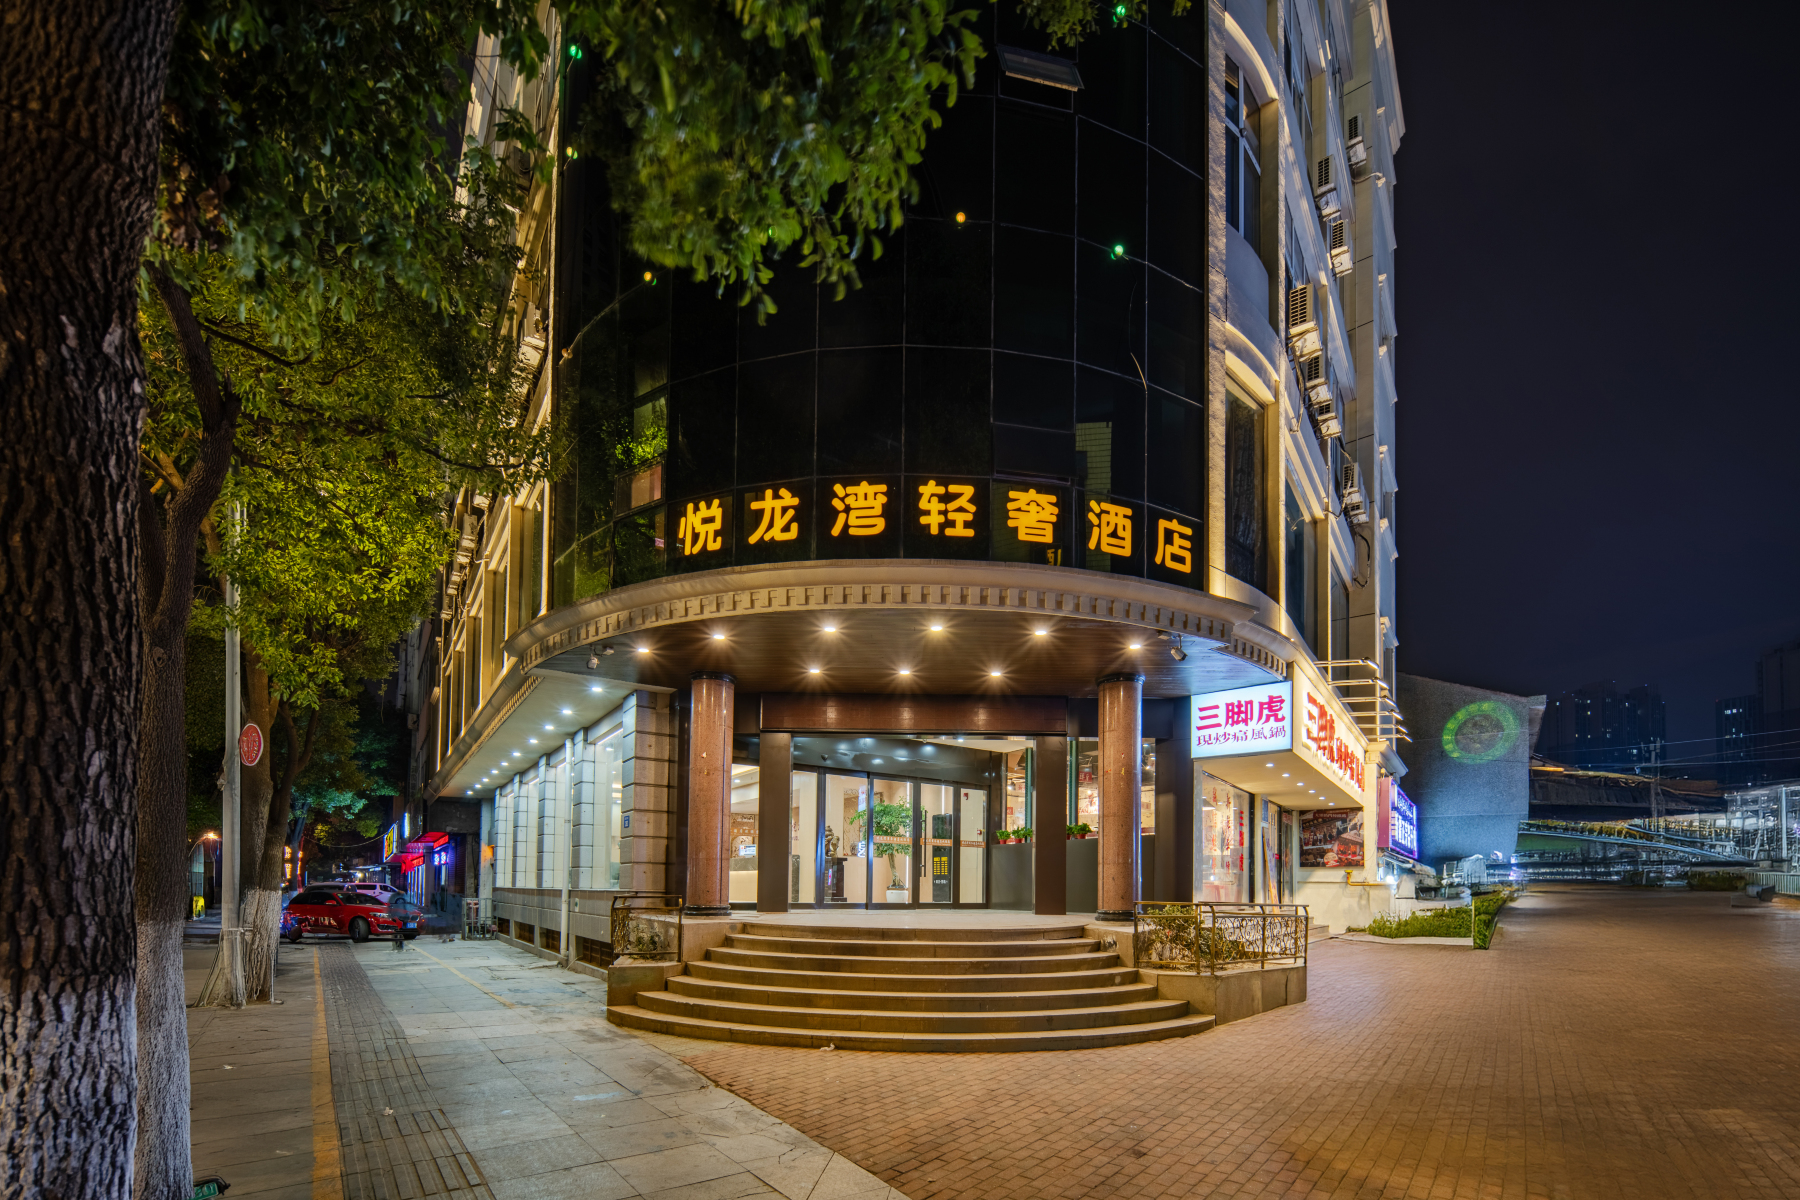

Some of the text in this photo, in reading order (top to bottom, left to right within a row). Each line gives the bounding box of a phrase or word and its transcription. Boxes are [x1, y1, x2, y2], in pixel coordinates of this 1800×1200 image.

[679, 480, 1193, 574] 悦龙湾轻奢酒店
[1196, 695, 1286, 731] 三脚虎
